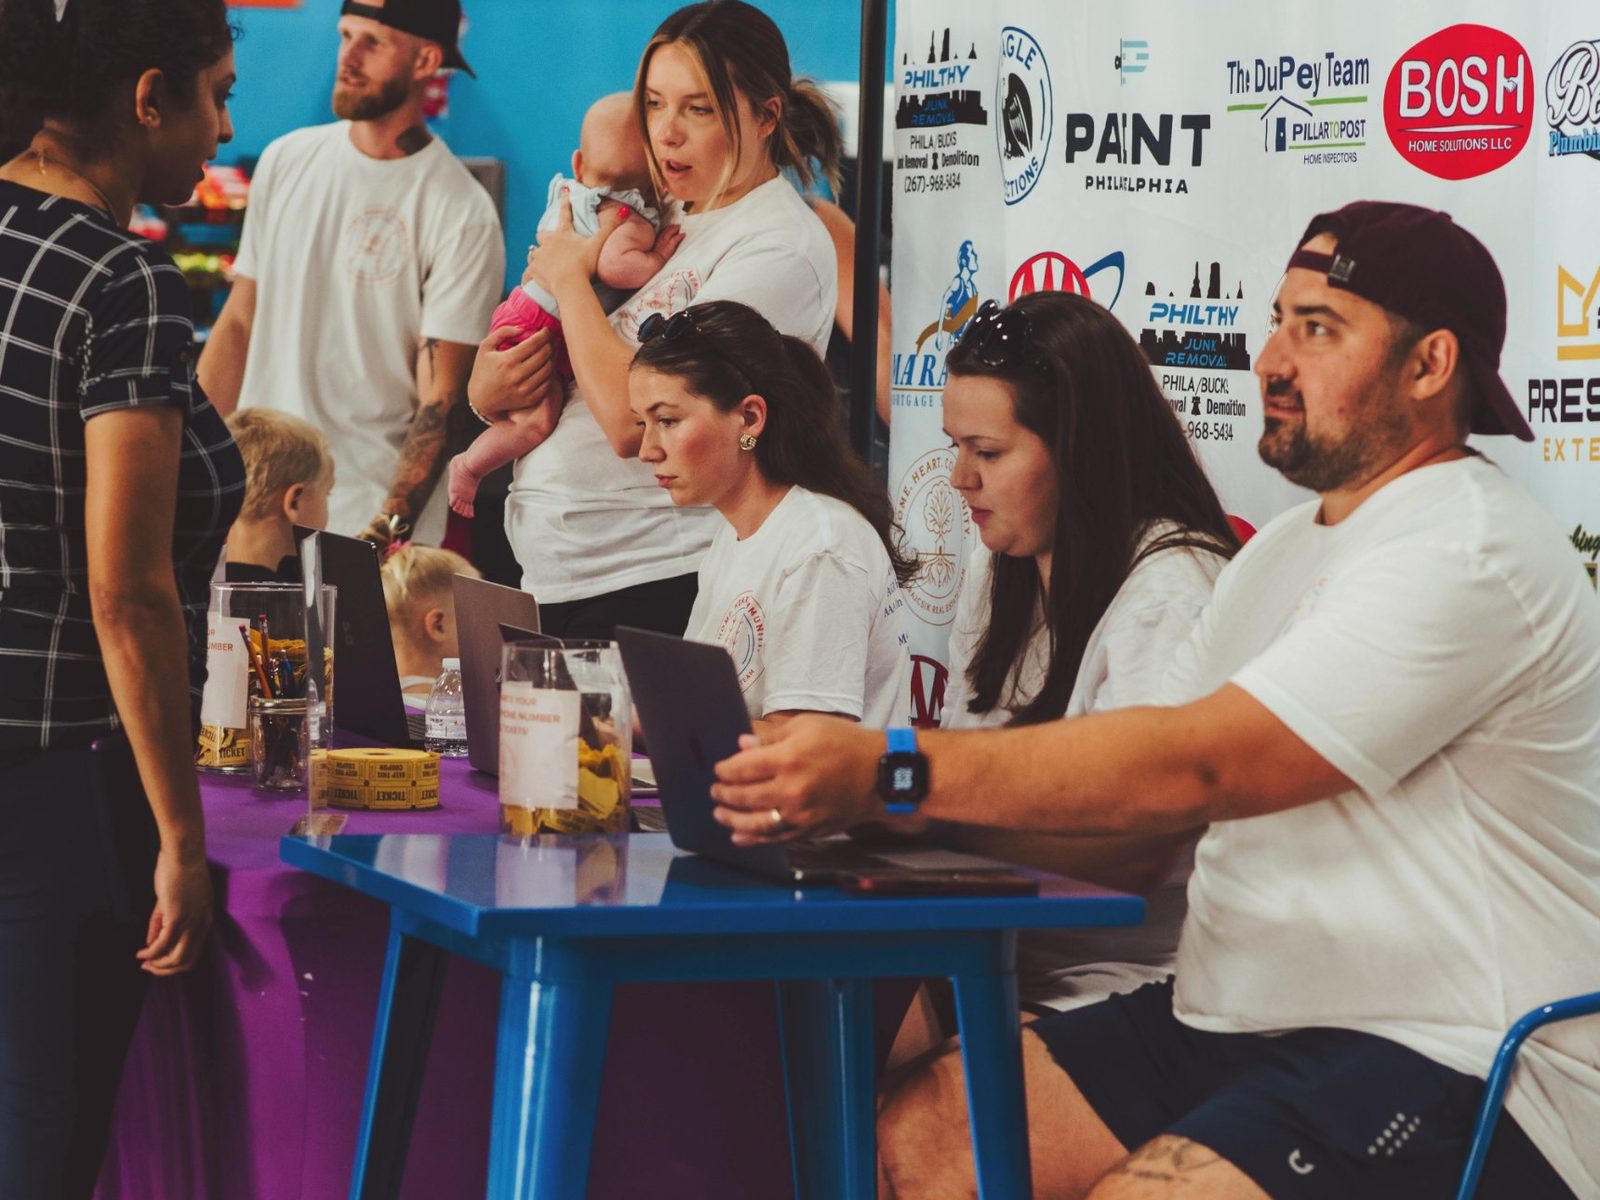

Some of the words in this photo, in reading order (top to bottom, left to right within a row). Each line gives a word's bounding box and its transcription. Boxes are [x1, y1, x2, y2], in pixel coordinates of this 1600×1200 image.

[904, 65, 970, 88] PHILTHY
[1227, 60, 1250, 94] The
[1254, 56, 1321, 97] DuPey
[1325, 52, 1369, 87] Team
[1399, 54, 1525, 118] BOSH
[1408, 141, 1437, 153] HOME
[1439, 137, 1488, 151] SOLUTIONS
[1490, 136, 1512, 150] LLC
[1303, 153, 1322, 165] HOME
[1149, 302, 1239, 326] PHILTHY
[219, 747, 246, 759] TICKET
[376, 790, 405, 801] TICKET
